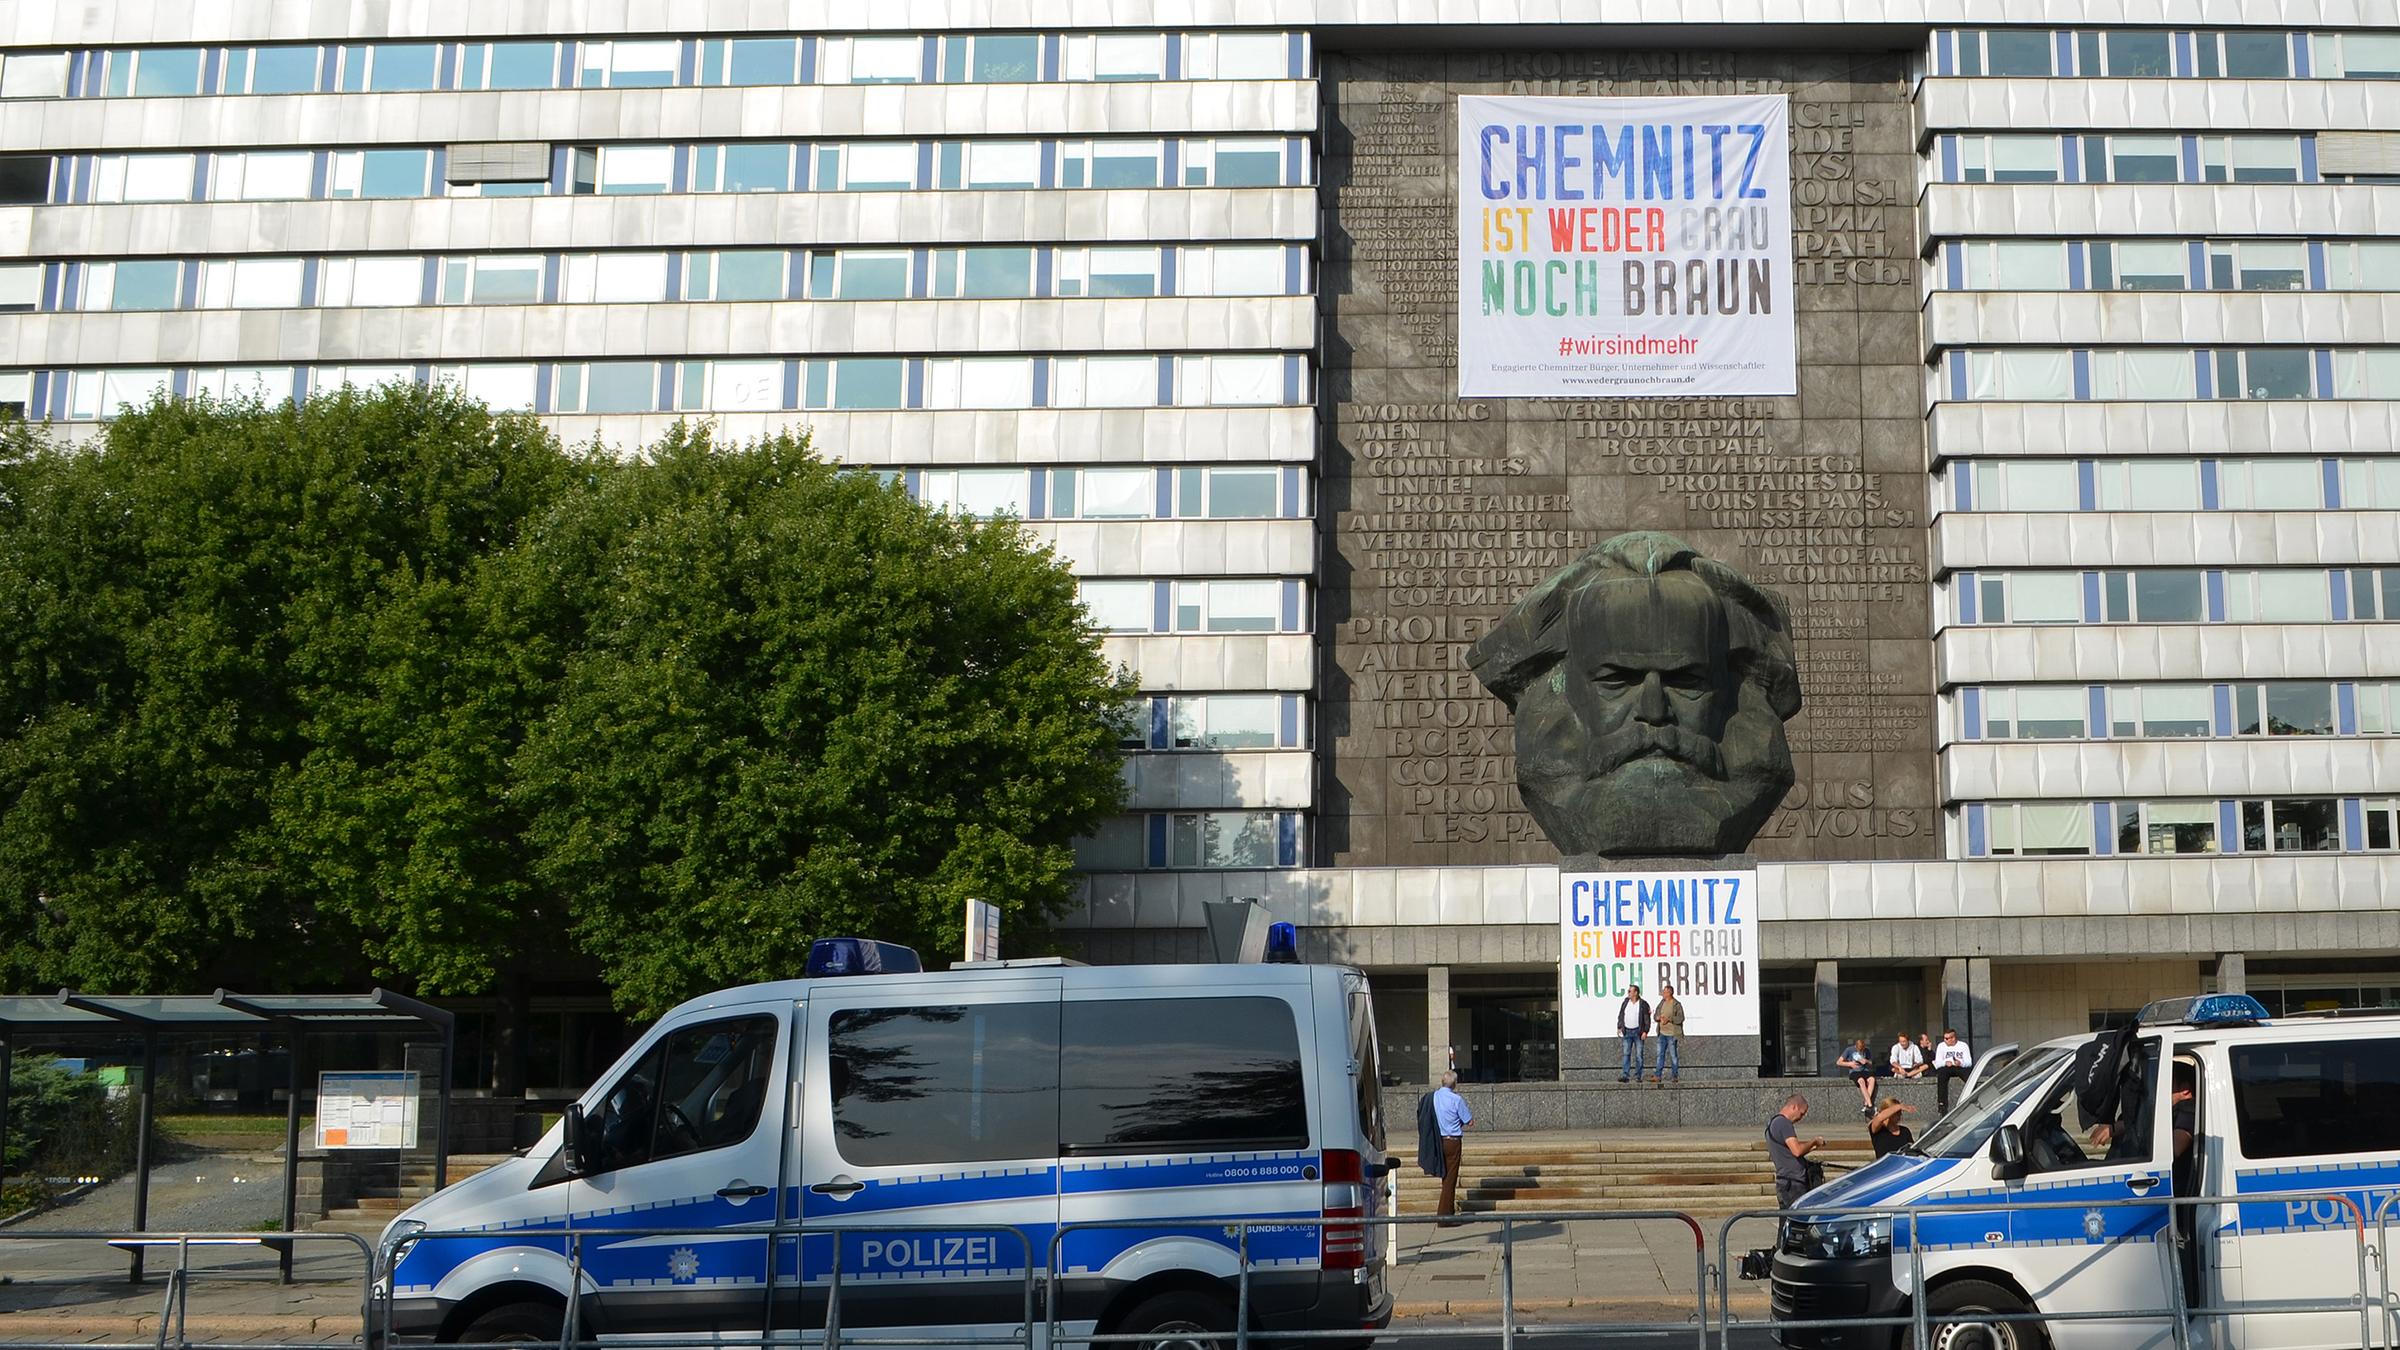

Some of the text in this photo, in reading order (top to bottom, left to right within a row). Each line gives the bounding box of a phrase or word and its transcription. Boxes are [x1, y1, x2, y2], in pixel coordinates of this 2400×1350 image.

[1358, 134, 1393, 145] MEN
[1363, 124, 1437, 135] WORKING
[1480, 124, 1767, 200] CHEMNITZ
[1791, 179, 1897, 207] OUS!
[1791, 206, 1885, 232] РИИ
[1482, 206, 1769, 253] IST WEDER GRAU
[1792, 232, 1895, 259] РАН,
[1793, 258, 1912, 286] ТЕСЬ!
[1481, 258, 1772, 317] NOCH BRAUN
[1559, 334, 1699, 356] #wirsindmehr
[1491, 361, 1766, 373] Engagierte Chemnitzer Bürger, Unternehmer und Wissenschaftler
[1562, 375, 1696, 386] www.wedergraunochbraun.de
[1351, 403, 1491, 422] WORKING
[1693, 402, 1774, 420] EUCH!
[1355, 421, 1421, 441] MEN
[1575, 420, 1766, 440] ПРОЛЕТАРИИ
[1367, 458, 1531, 478] COUNTRIES,
[1377, 476, 1473, 496] UNITE!
[1658, 473, 1882, 493] PROLETAIRES DE
[1386, 495, 1574, 515] PROLETARIER
[1685, 491, 1891, 512] TOUS LES PAYS,
[1355, 530, 1507, 551] VEREINIGT
[1735, 528, 1877, 548] WORKING
[1369, 551, 1562, 570] ПРОЛЕТАРИИ
[1759, 546, 1825, 566] MEN
[1379, 569, 1450, 589] ВСЕХ
[1782, 565, 1927, 584] COUNTRIES,
[1807, 583, 1904, 602] UNITE!
[1362, 672, 1495, 701] VEREI
[1387, 729, 1501, 758] ВСЕХ
[1412, 814, 1489, 843] LES
[1572, 878, 1741, 926] CHEMNITZ
[1573, 929, 1742, 959] IST WEDER GRAU
[1574, 961, 1745, 998] NOCH BRAUN
[1224, 1168, 1249, 1177] 0800
[1251, 1167, 1258, 1176] 6
[1259, 1166, 1279, 1176] 888
[1280, 1165, 1299, 1174] 000
[863, 1237, 996, 1267] POLIZEI
